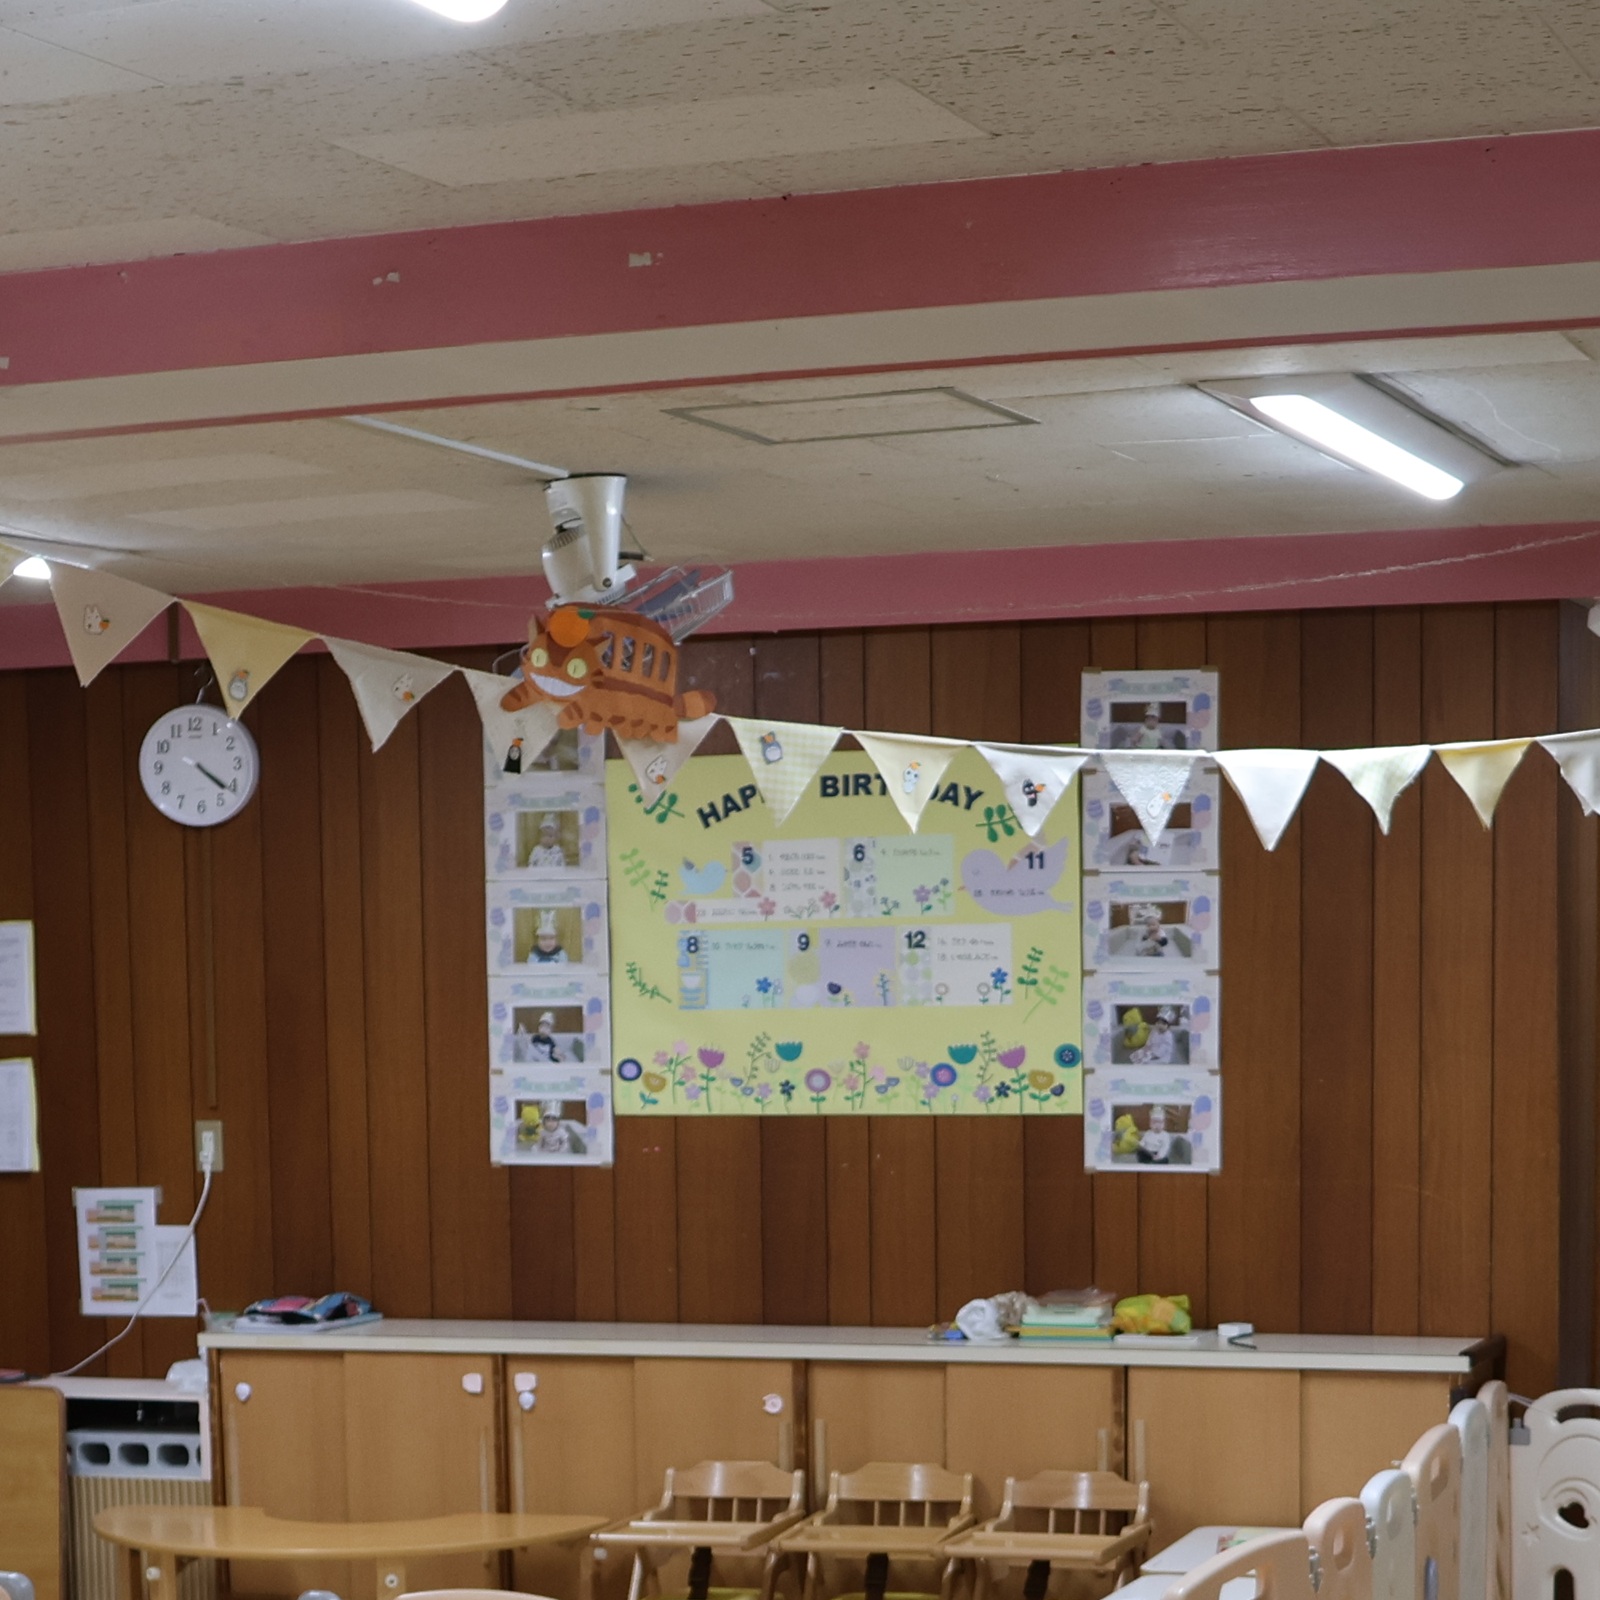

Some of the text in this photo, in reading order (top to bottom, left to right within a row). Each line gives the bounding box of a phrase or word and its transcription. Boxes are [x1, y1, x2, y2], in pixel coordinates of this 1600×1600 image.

[170, 724, 182, 738] 11
[188, 717, 202, 731] 12
[156, 740, 170, 754] 10
[226, 736, 235, 751] 2
[154, 761, 163, 775] 9
[233, 756, 242, 771] 3
[161, 781, 170, 795] 8
[227, 778, 237, 792] 4
[177, 795, 185, 809] 7
[216, 793, 225, 807] 5
[696, 773, 984, 829] HAP BIRTAY
[197, 801, 206, 814] 6
[742, 846, 754, 865] 5
[853, 843, 866, 862] 6
[1025, 851, 1045, 870] 11
[686, 935, 699, 954] 8
[797, 933, 810, 951] 9
[904, 930, 926, 949] 12
